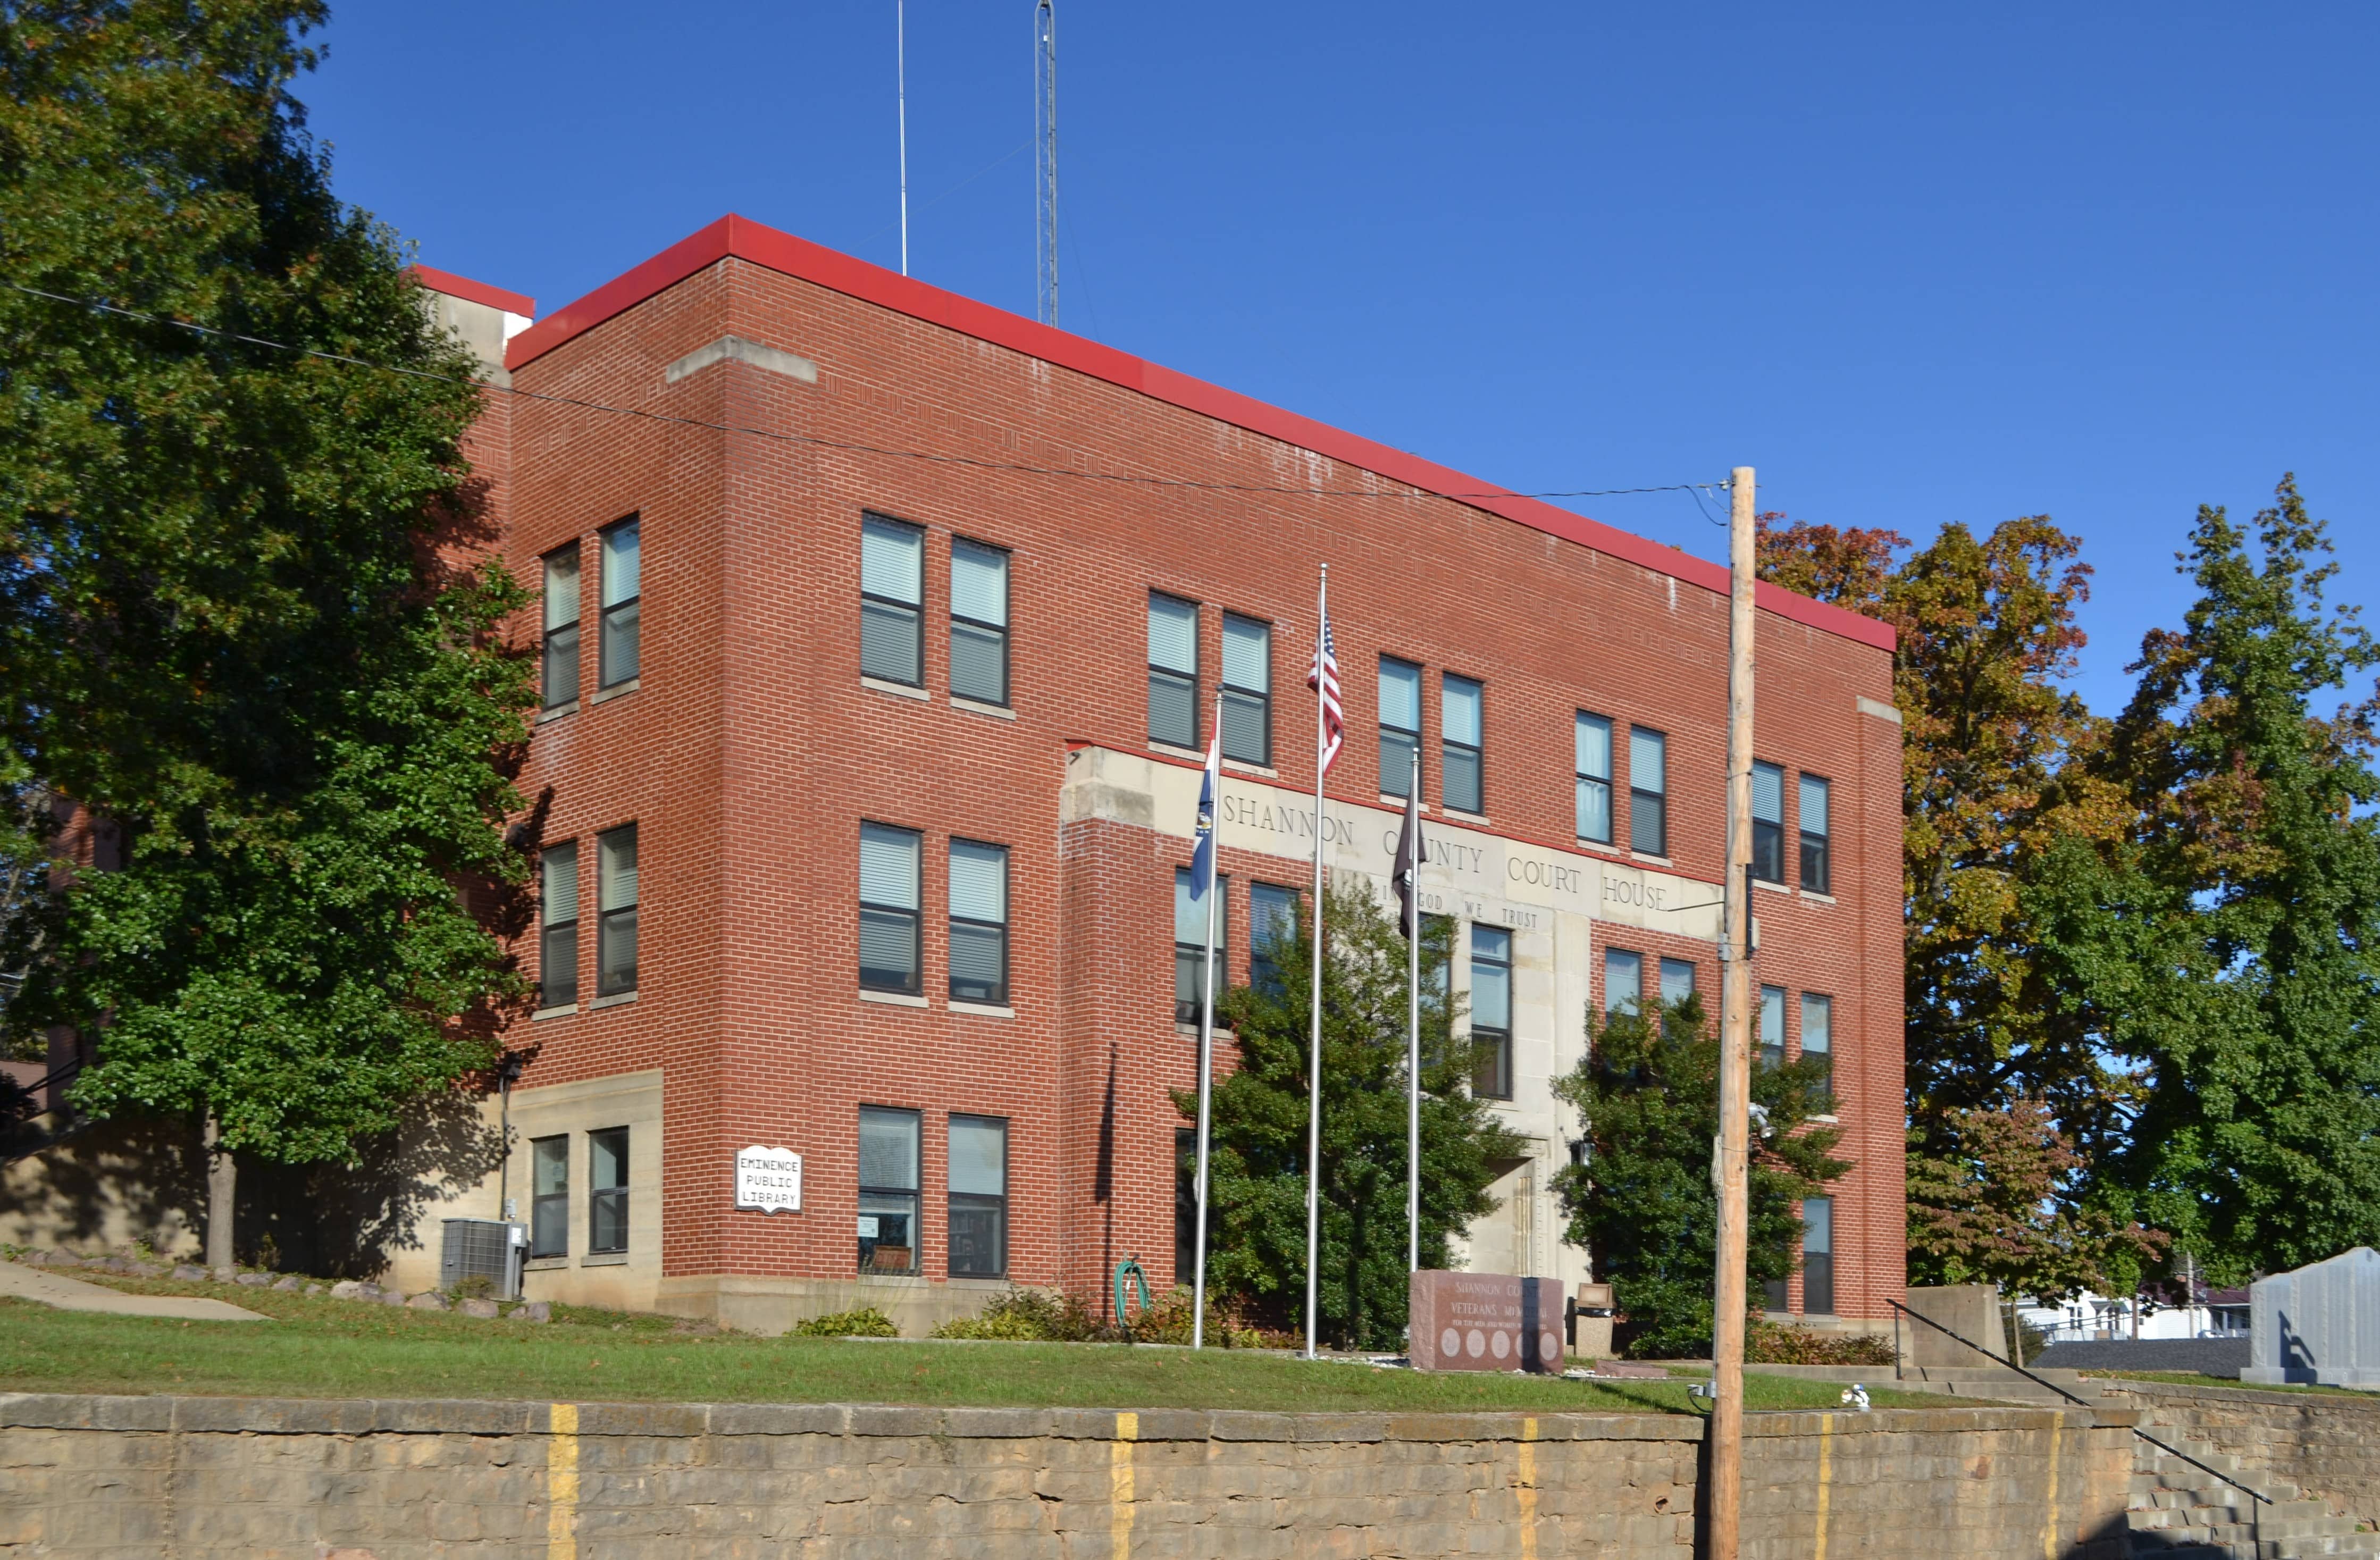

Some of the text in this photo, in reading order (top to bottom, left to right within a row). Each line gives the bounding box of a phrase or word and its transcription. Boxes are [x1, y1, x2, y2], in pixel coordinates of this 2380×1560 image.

[1223, 795, 1666, 911] SHANNON CUNTY COURT HOUSE
[1417, 892, 1442, 910] GOD
[1464, 901, 1482, 917] WE
[1502, 908, 1537, 928] TRUST
[740, 1158, 799, 1172] EMINENCE
[747, 1175, 792, 1188] PUBLIC
[743, 1192, 796, 1204] LIBRARY
[1455, 1281, 1500, 1295] SHANNON
[1451, 1302, 1497, 1315] VETERANS
